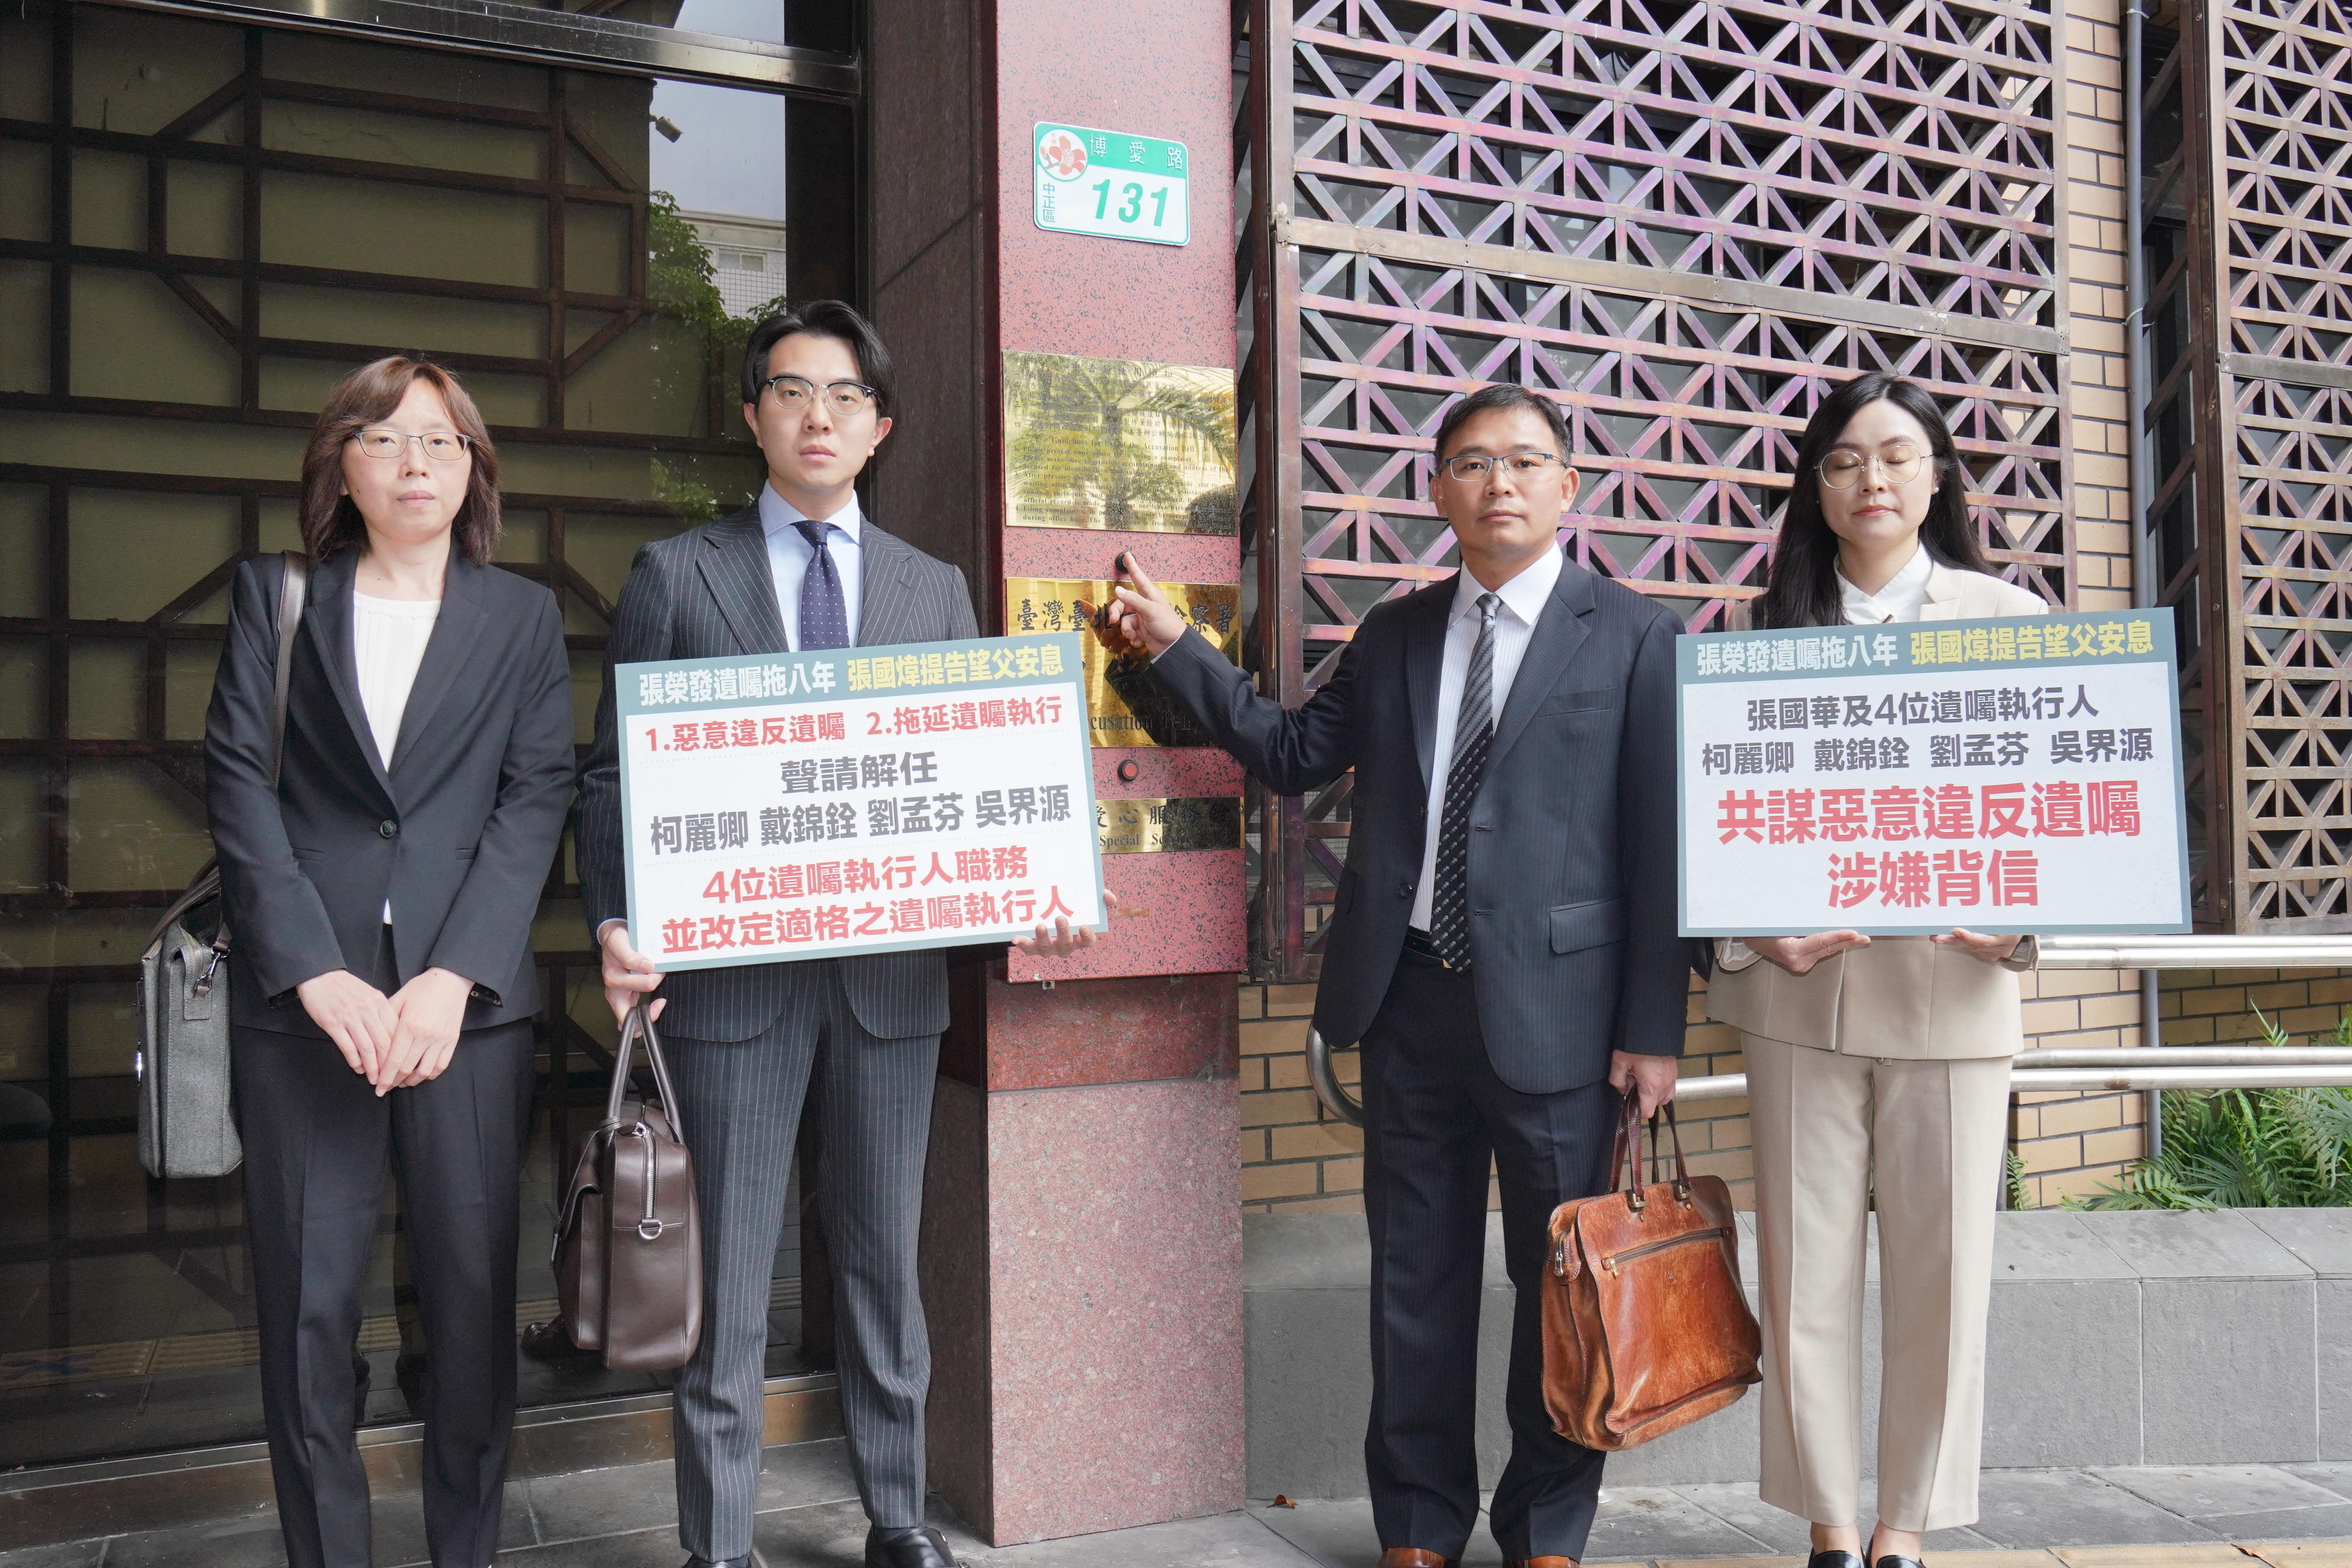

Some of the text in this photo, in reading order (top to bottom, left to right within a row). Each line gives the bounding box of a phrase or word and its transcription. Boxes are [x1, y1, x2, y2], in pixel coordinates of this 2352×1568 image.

[1089, 134, 1183, 170] 博愛路
[1043, 182, 1056, 223] 中正區
[1092, 179, 1168, 227] 131
[1052, 436, 1088, 446] Guidelines
[1144, 443, 1178, 452] Accusation
[1023, 505, 1044, 514] Filing
[1047, 507, 1086, 515] complaint(s)
[1017, 598, 1235, 635] 臺灣臺北察署
[1697, 619, 2154, 676] 張榮發遺囑拖八年 張國煒提告望父安息
[639, 661, 837, 706] 張榮發遺囑拖八年
[847, 643, 1064, 691] 張國煒提告望父安息
[1089, 712, 1153, 731] cusation
[1747, 684, 2099, 731] 張國華及4位遺囑執行人
[780, 751, 937, 794] 聲請解任
[1702, 727, 2154, 776] 柯麗卿 戴錦銓 劉孟芬 吳界源
[651, 784, 1072, 855] 柯麗卿 戴錦銓 劉孟芬 吳界源
[1717, 780, 2141, 845] 共謀惡意違反遺囑
[1099, 834, 1140, 850] Special
[703, 845, 1028, 904] 4位遺囑執行人職務
[1827, 849, 2038, 909] 涉嫌背信
[662, 886, 1074, 954] 並改定適格之遺囑執行人
